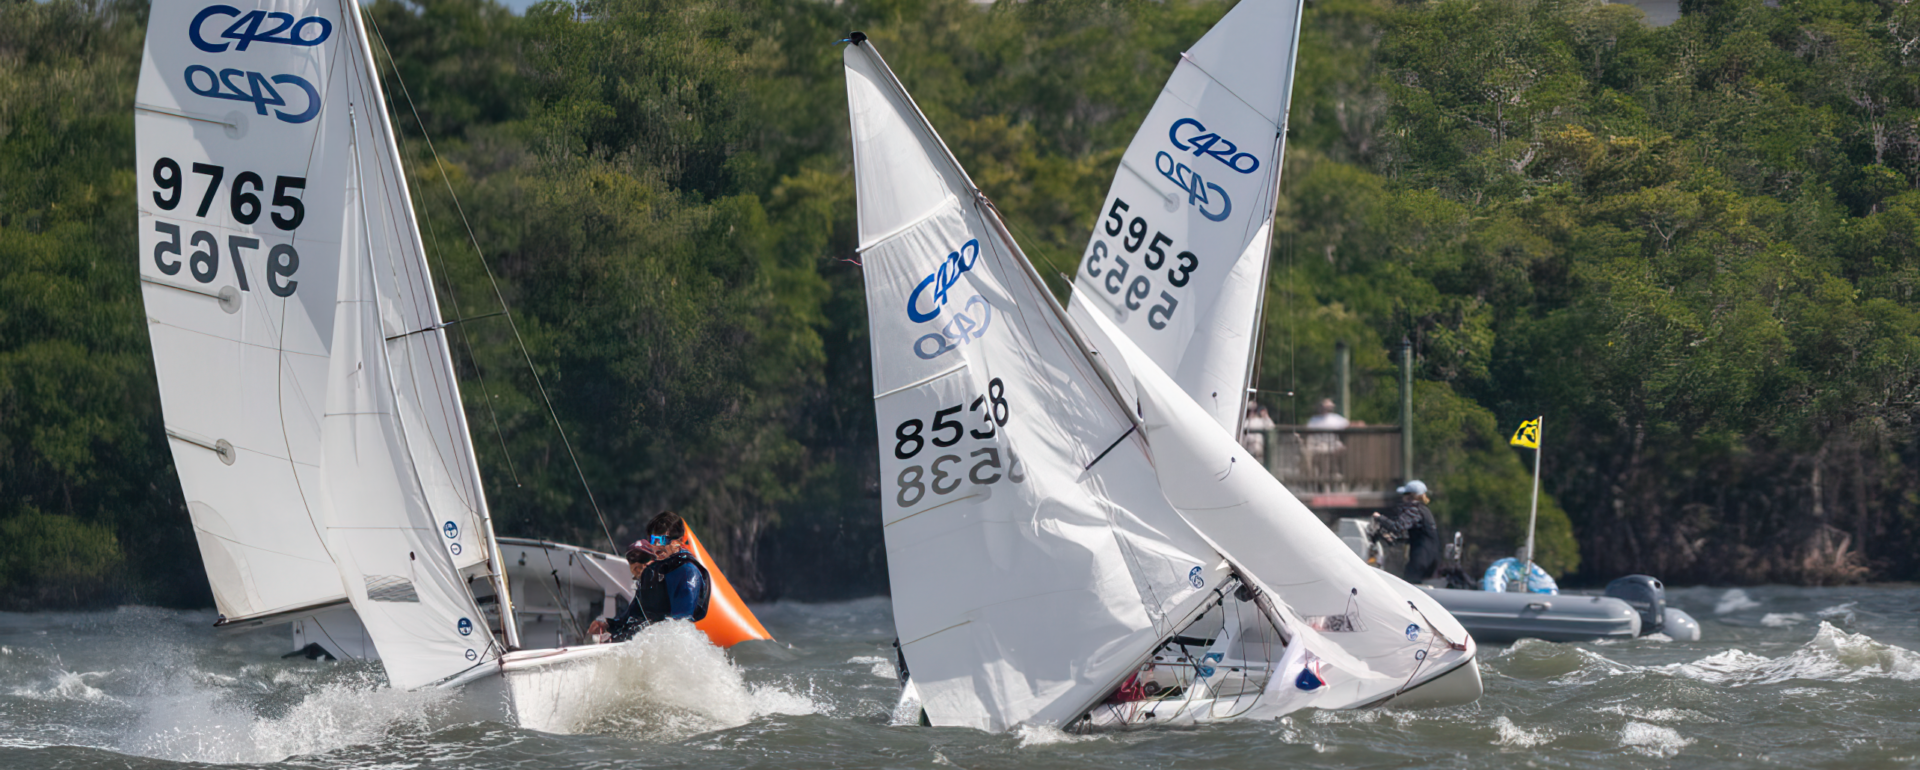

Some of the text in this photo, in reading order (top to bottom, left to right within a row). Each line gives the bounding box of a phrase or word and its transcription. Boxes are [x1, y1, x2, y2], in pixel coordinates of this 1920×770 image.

[188, 4, 333, 53] C420
[1168, 117, 1260, 174] C420
[152, 157, 307, 231] 9765
[906, 238, 980, 324] C420
[1104, 197, 1199, 288] 5953
[894, 376, 1009, 460] 8538
